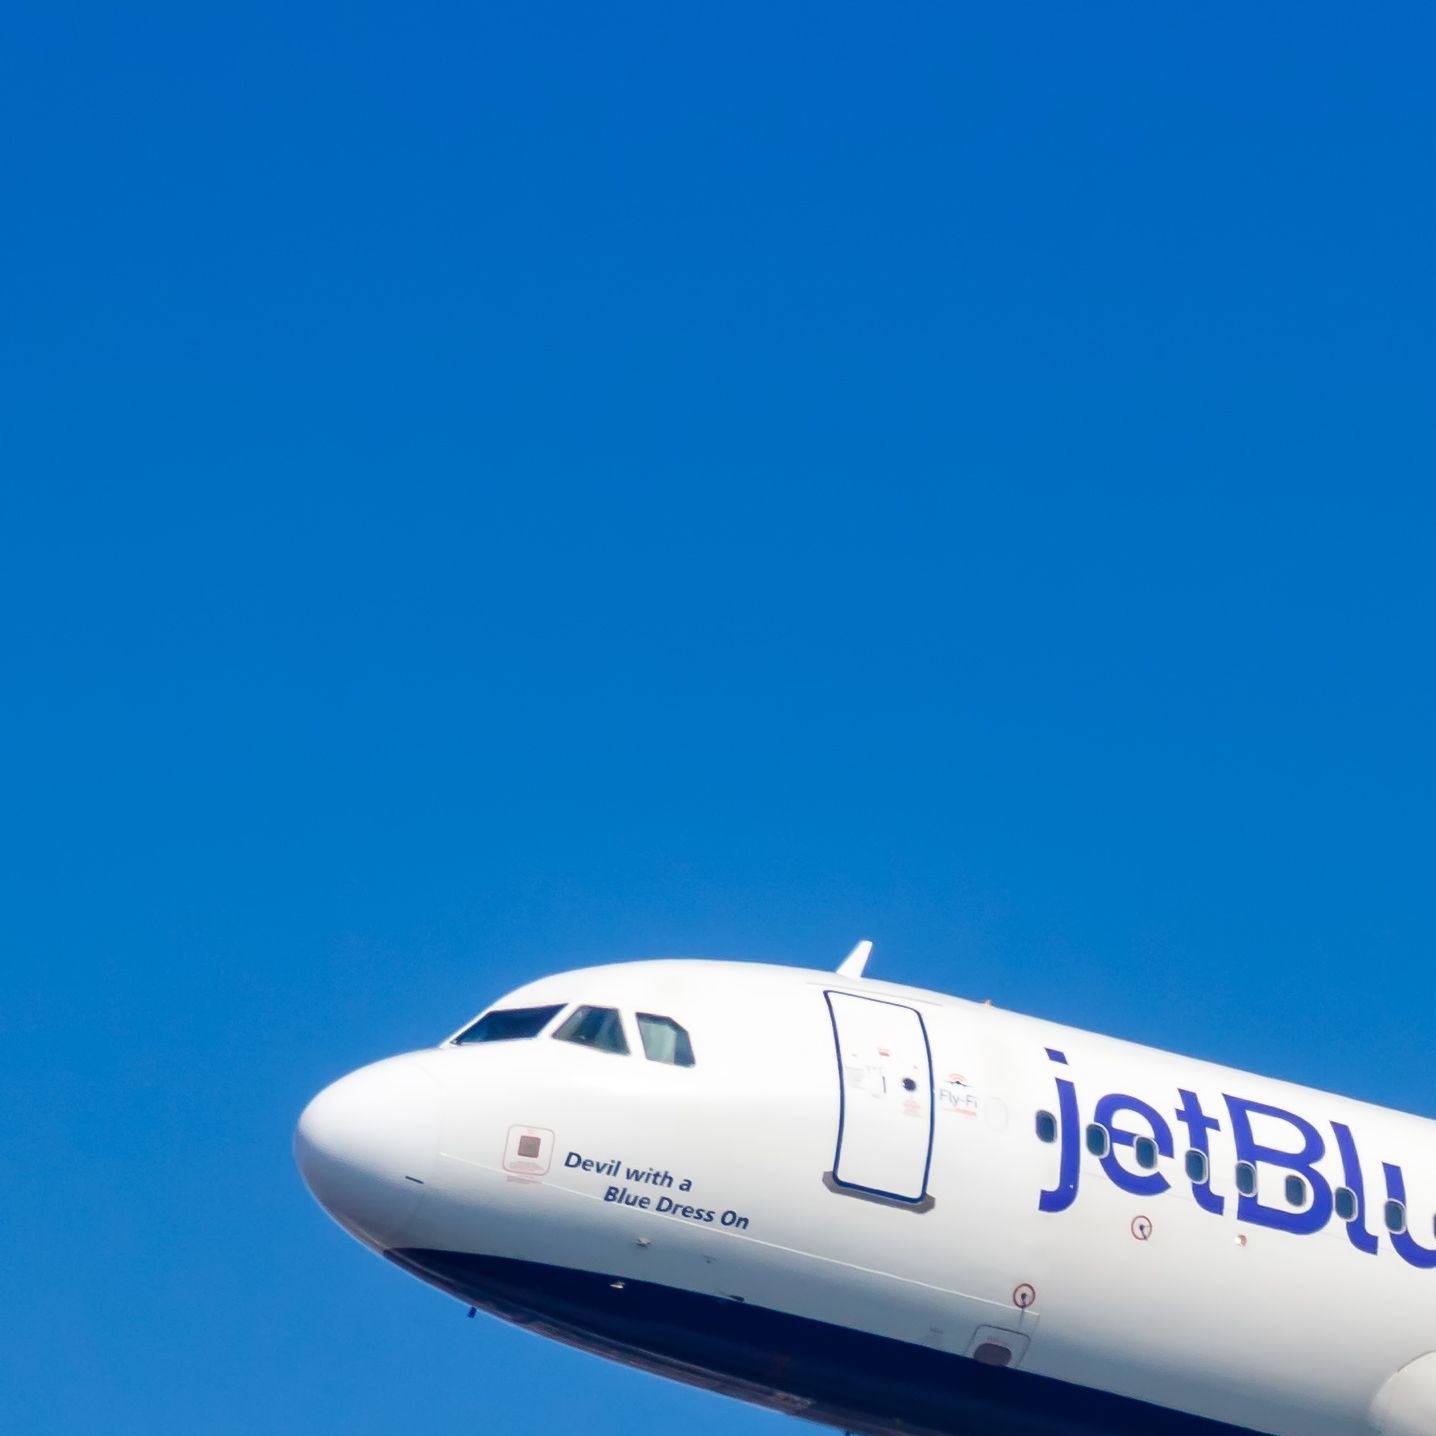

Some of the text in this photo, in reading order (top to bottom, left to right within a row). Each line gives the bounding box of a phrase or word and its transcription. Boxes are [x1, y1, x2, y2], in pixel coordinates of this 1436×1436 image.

[564, 1151, 622, 1177] Devil
[625, 1167, 674, 1188] with
[678, 1178, 693, 1192] a
[603, 1185, 750, 1230] Blue Dress On
